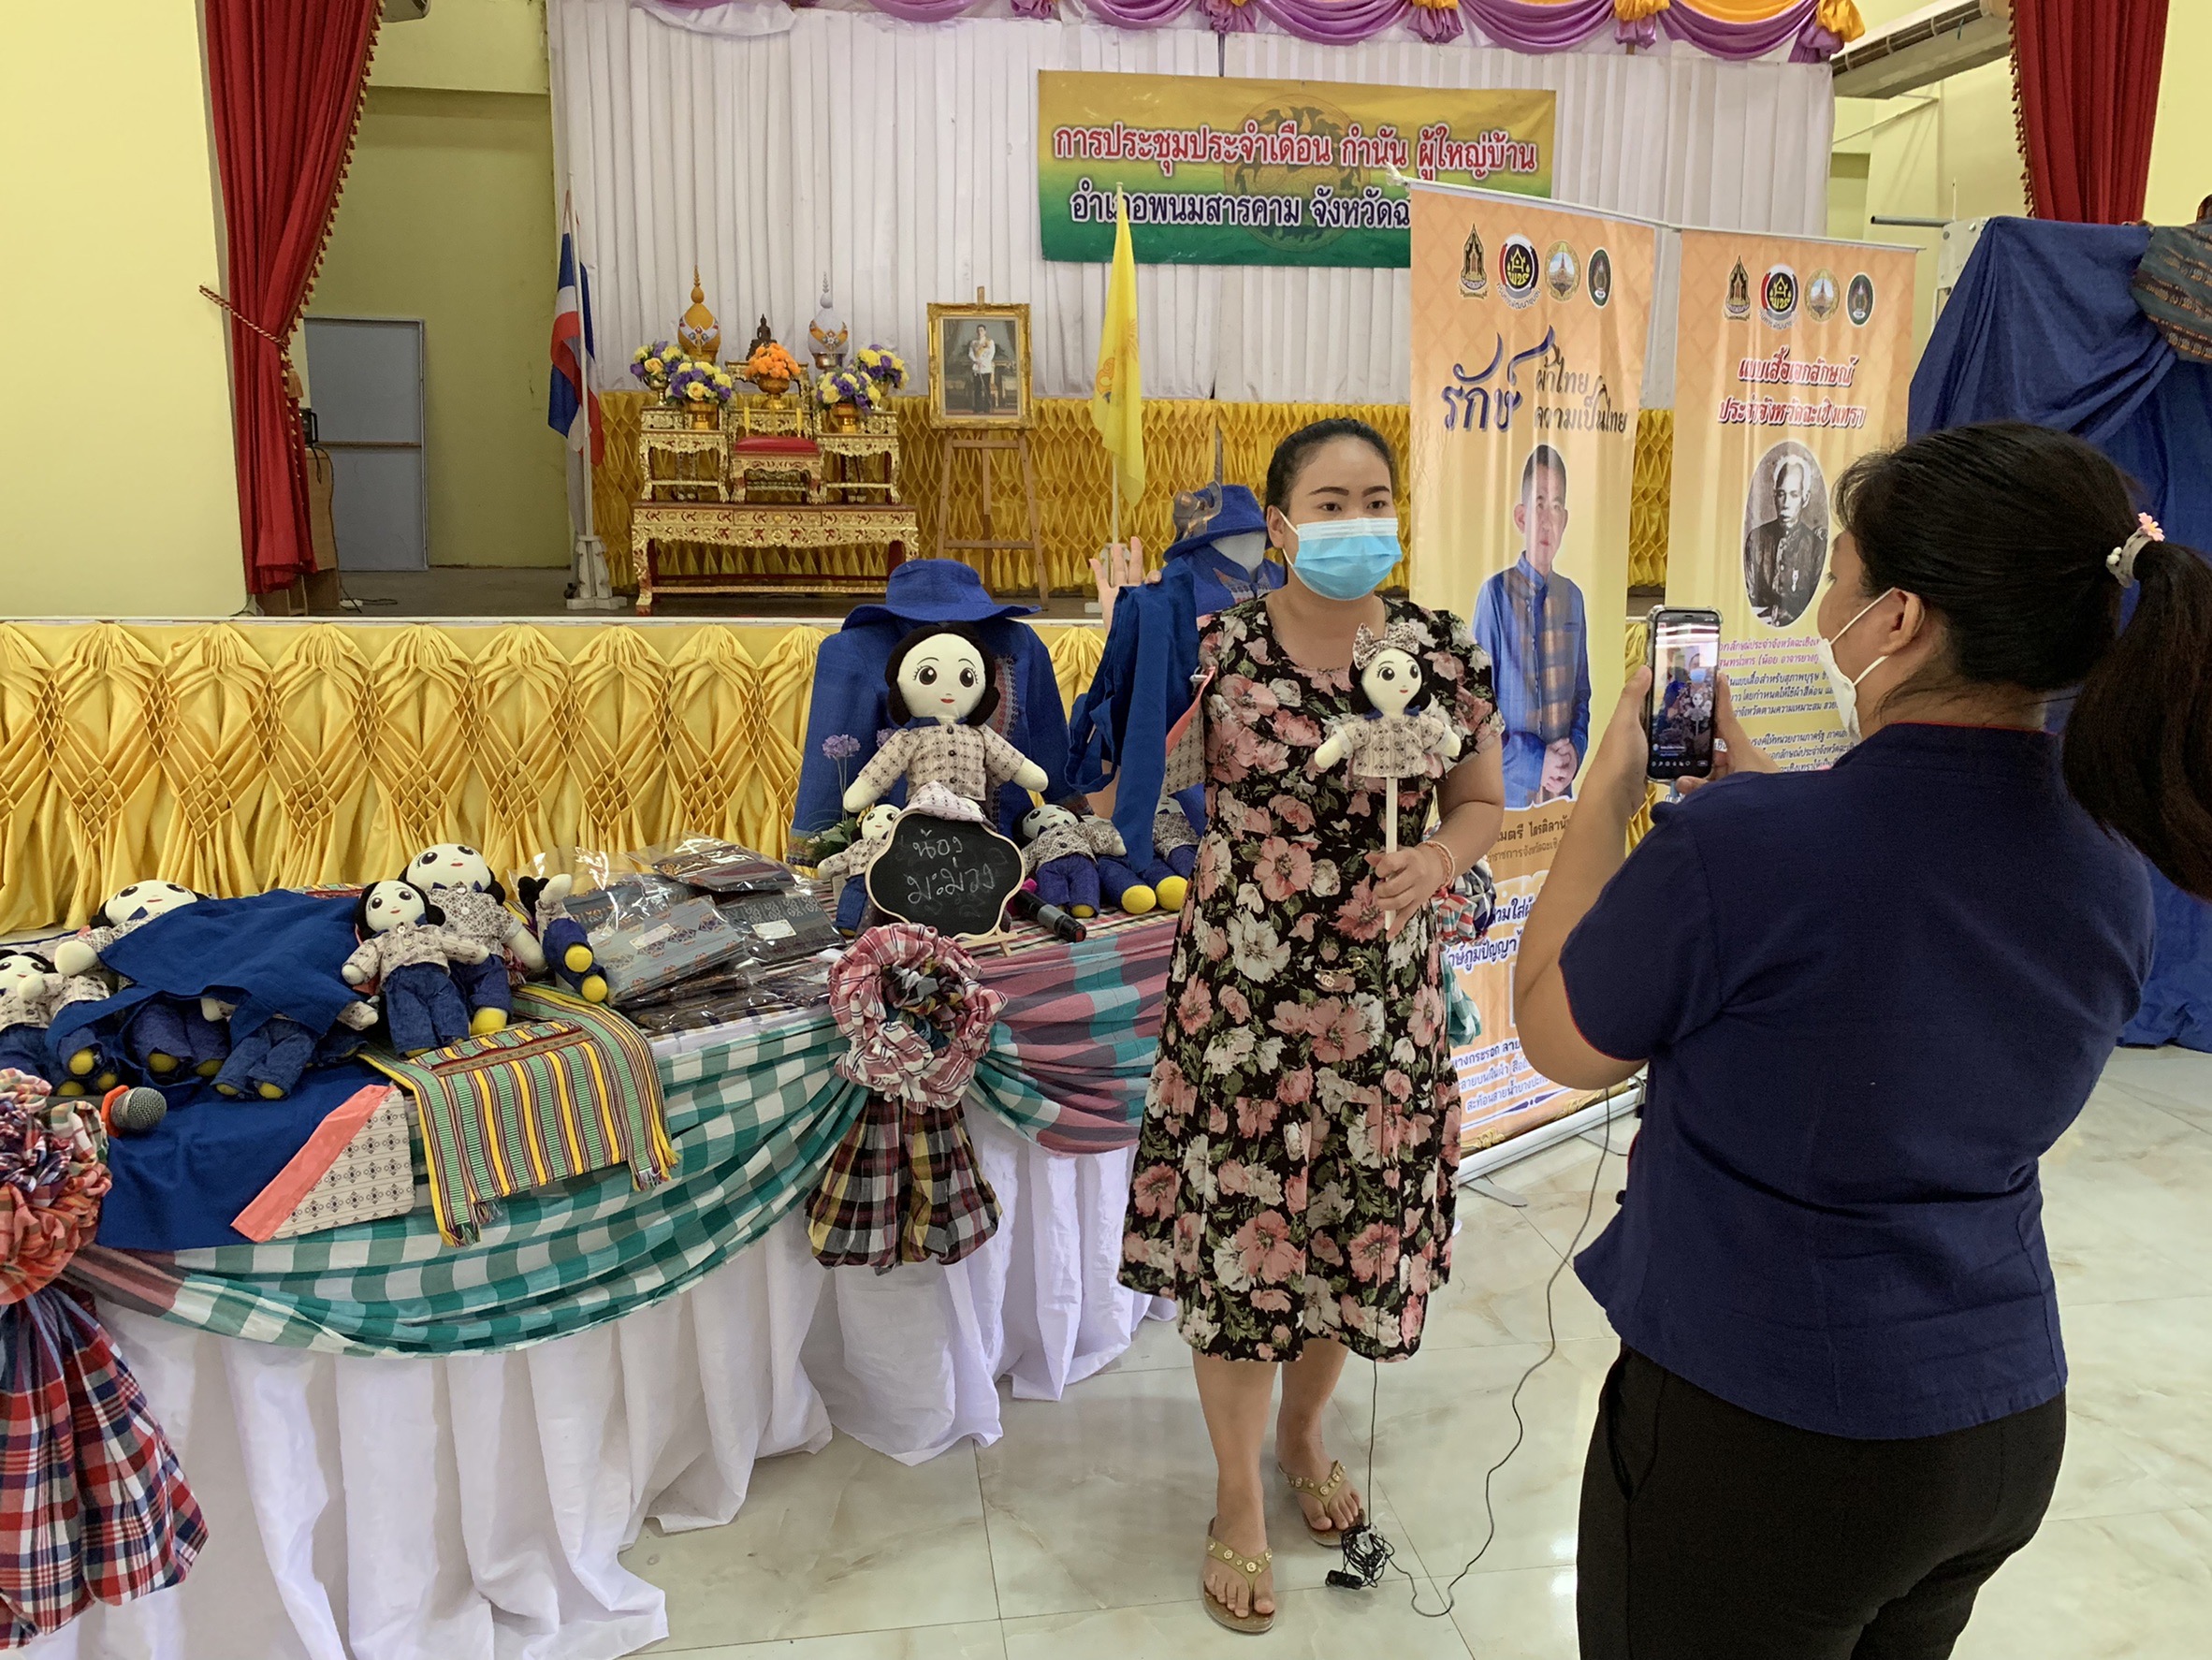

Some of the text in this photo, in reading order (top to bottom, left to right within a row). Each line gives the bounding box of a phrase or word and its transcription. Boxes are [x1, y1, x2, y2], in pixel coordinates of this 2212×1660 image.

[1054, 121, 1537, 181] การประชุมประจำเดือน กำนัน ผู้ใหญ่บ้าน
[912, 828, 963, 860] น้อง
[1497, 823, 1525, 843] มตรี
[904, 856, 996, 905] มะม่วง
